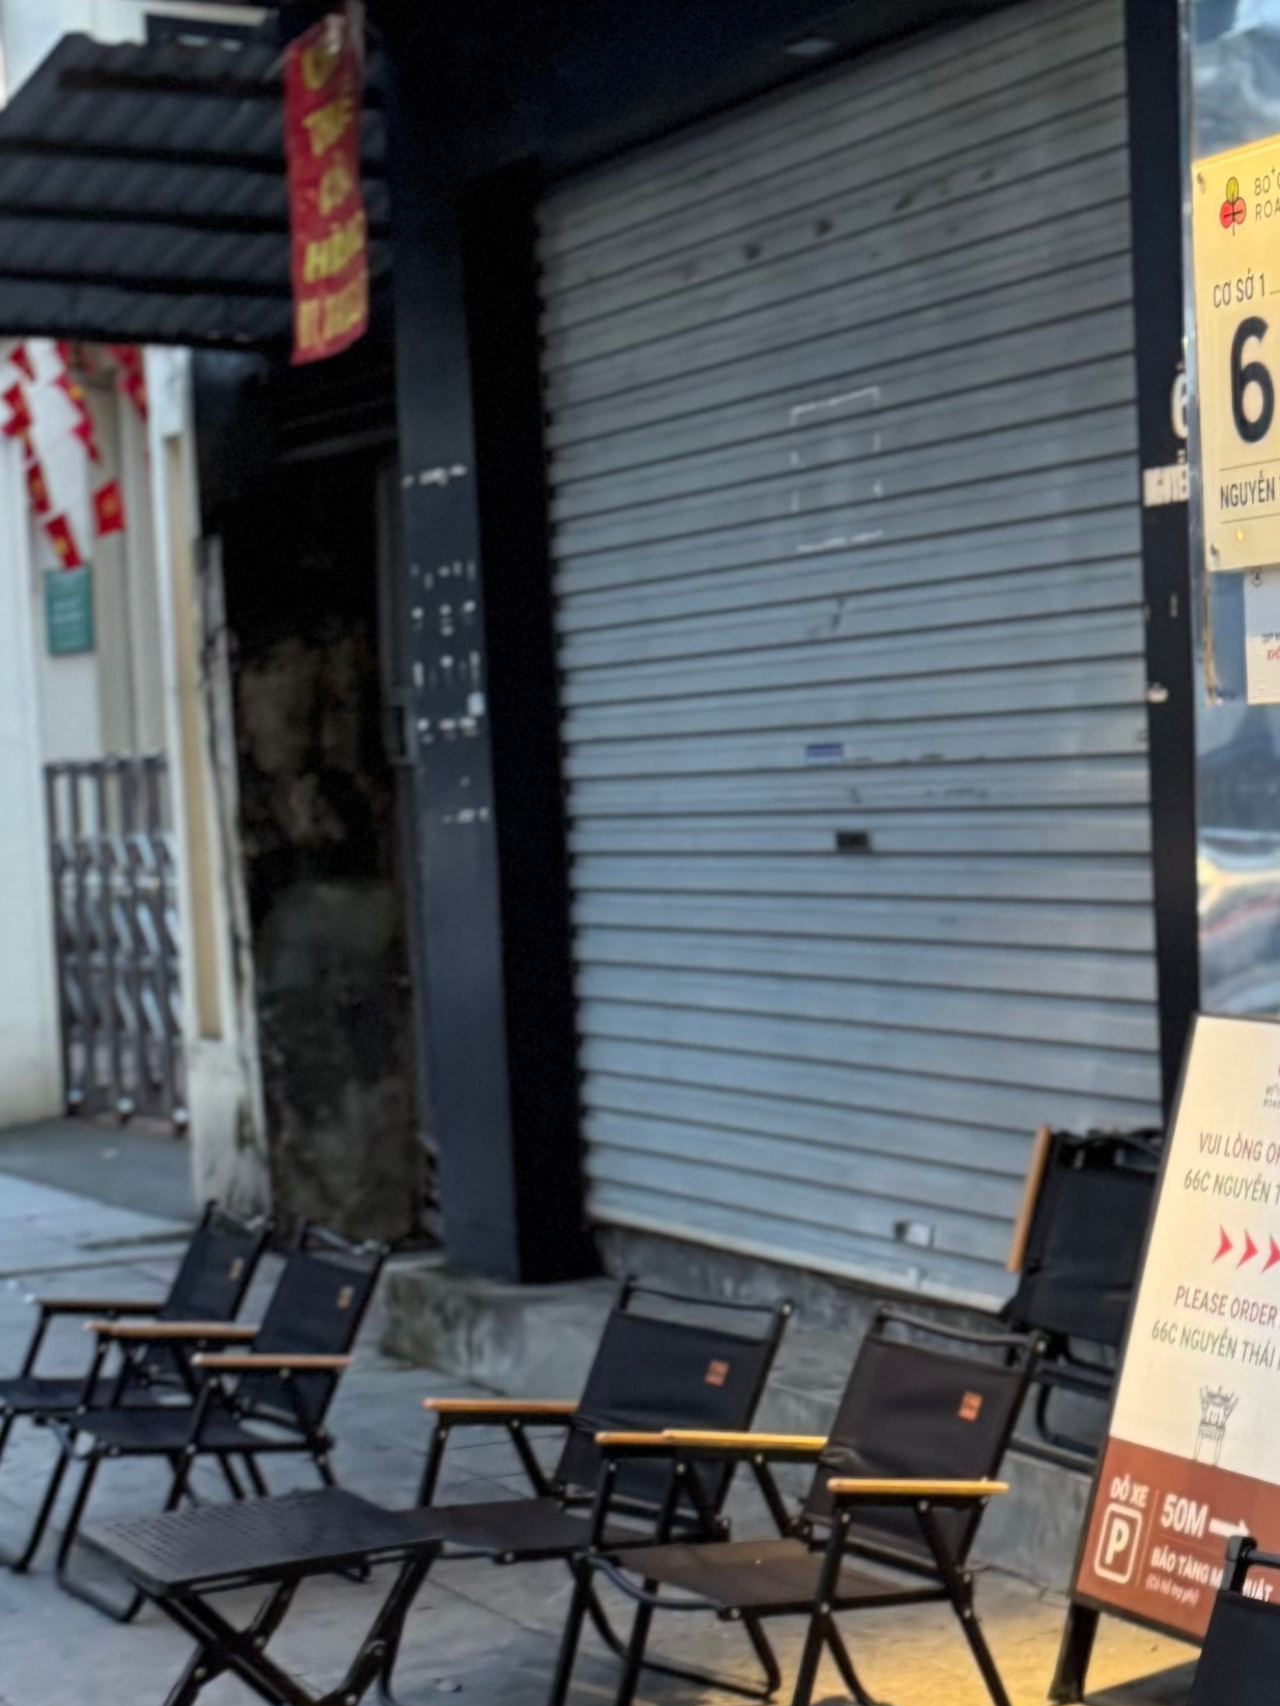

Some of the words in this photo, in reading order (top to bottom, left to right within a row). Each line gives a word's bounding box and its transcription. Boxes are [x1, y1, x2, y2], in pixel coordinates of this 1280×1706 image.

[1213, 281, 1232, 308] CƠ
[1236, 267, 1254, 302] SỞ
[1259, 272, 1265, 297] 1
[1220, 470, 1275, 510] NGUYỄN
[1200, 1132, 1222, 1155] VUI
[1224, 1132, 1263, 1161] LÒNG
[1184, 1169, 1211, 1193] 66C
[1174, 1285, 1228, 1316] PLEASE
[1230, 1297, 1278, 1328] ORDER
[1152, 1319, 1178, 1345] 66C
[1241, 1340, 1276, 1369] THÁI
[1129, 1483, 1150, 1508] XE
[1160, 1493, 1208, 1538] 50M
[1105, 1517, 1130, 1565] P
